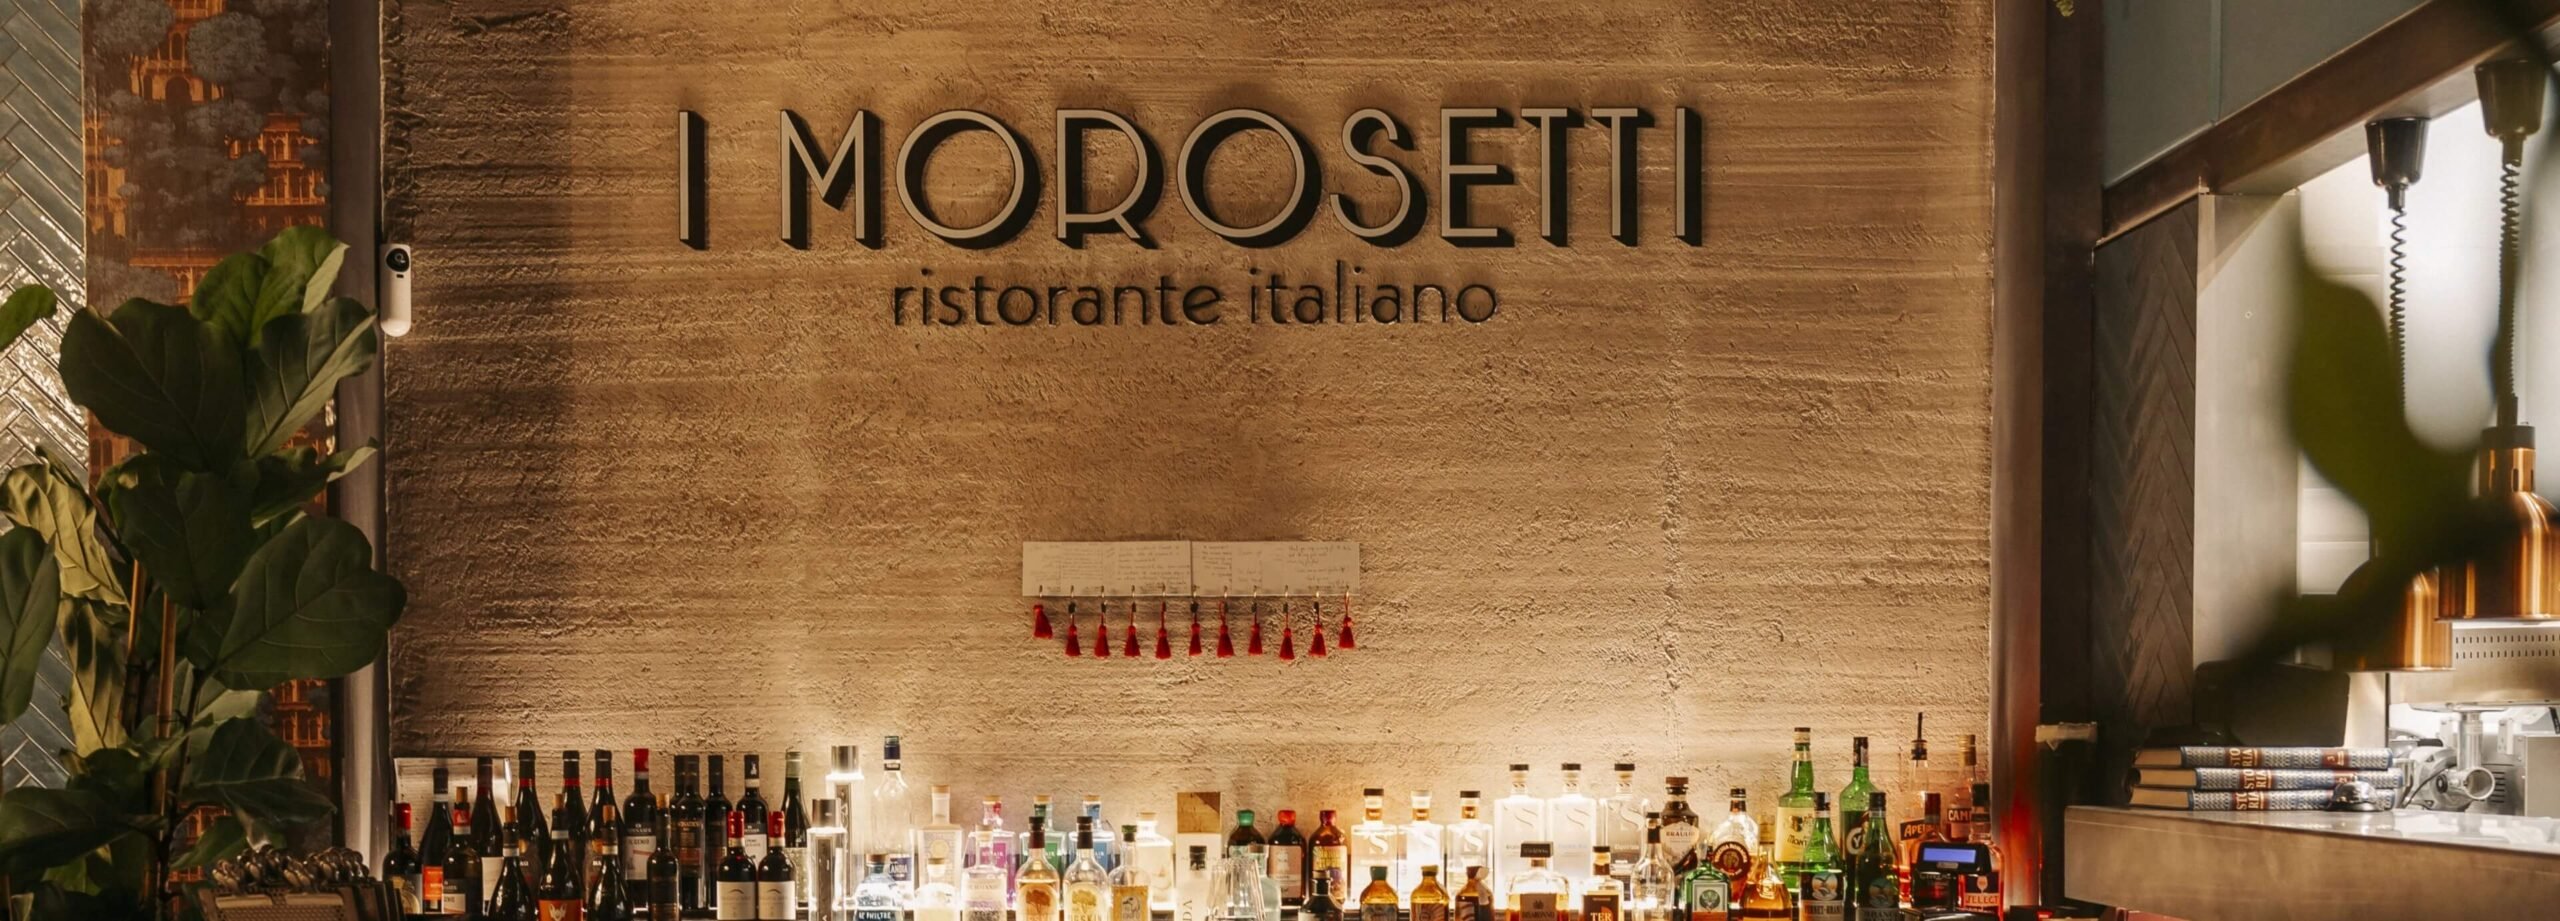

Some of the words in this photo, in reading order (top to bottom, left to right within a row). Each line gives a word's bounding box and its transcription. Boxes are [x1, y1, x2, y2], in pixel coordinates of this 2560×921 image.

[780, 108, 1690, 243] MOROSETTI
[892, 268, 1221, 326] ristorante
[1250, 259, 1498, 325] italiano
